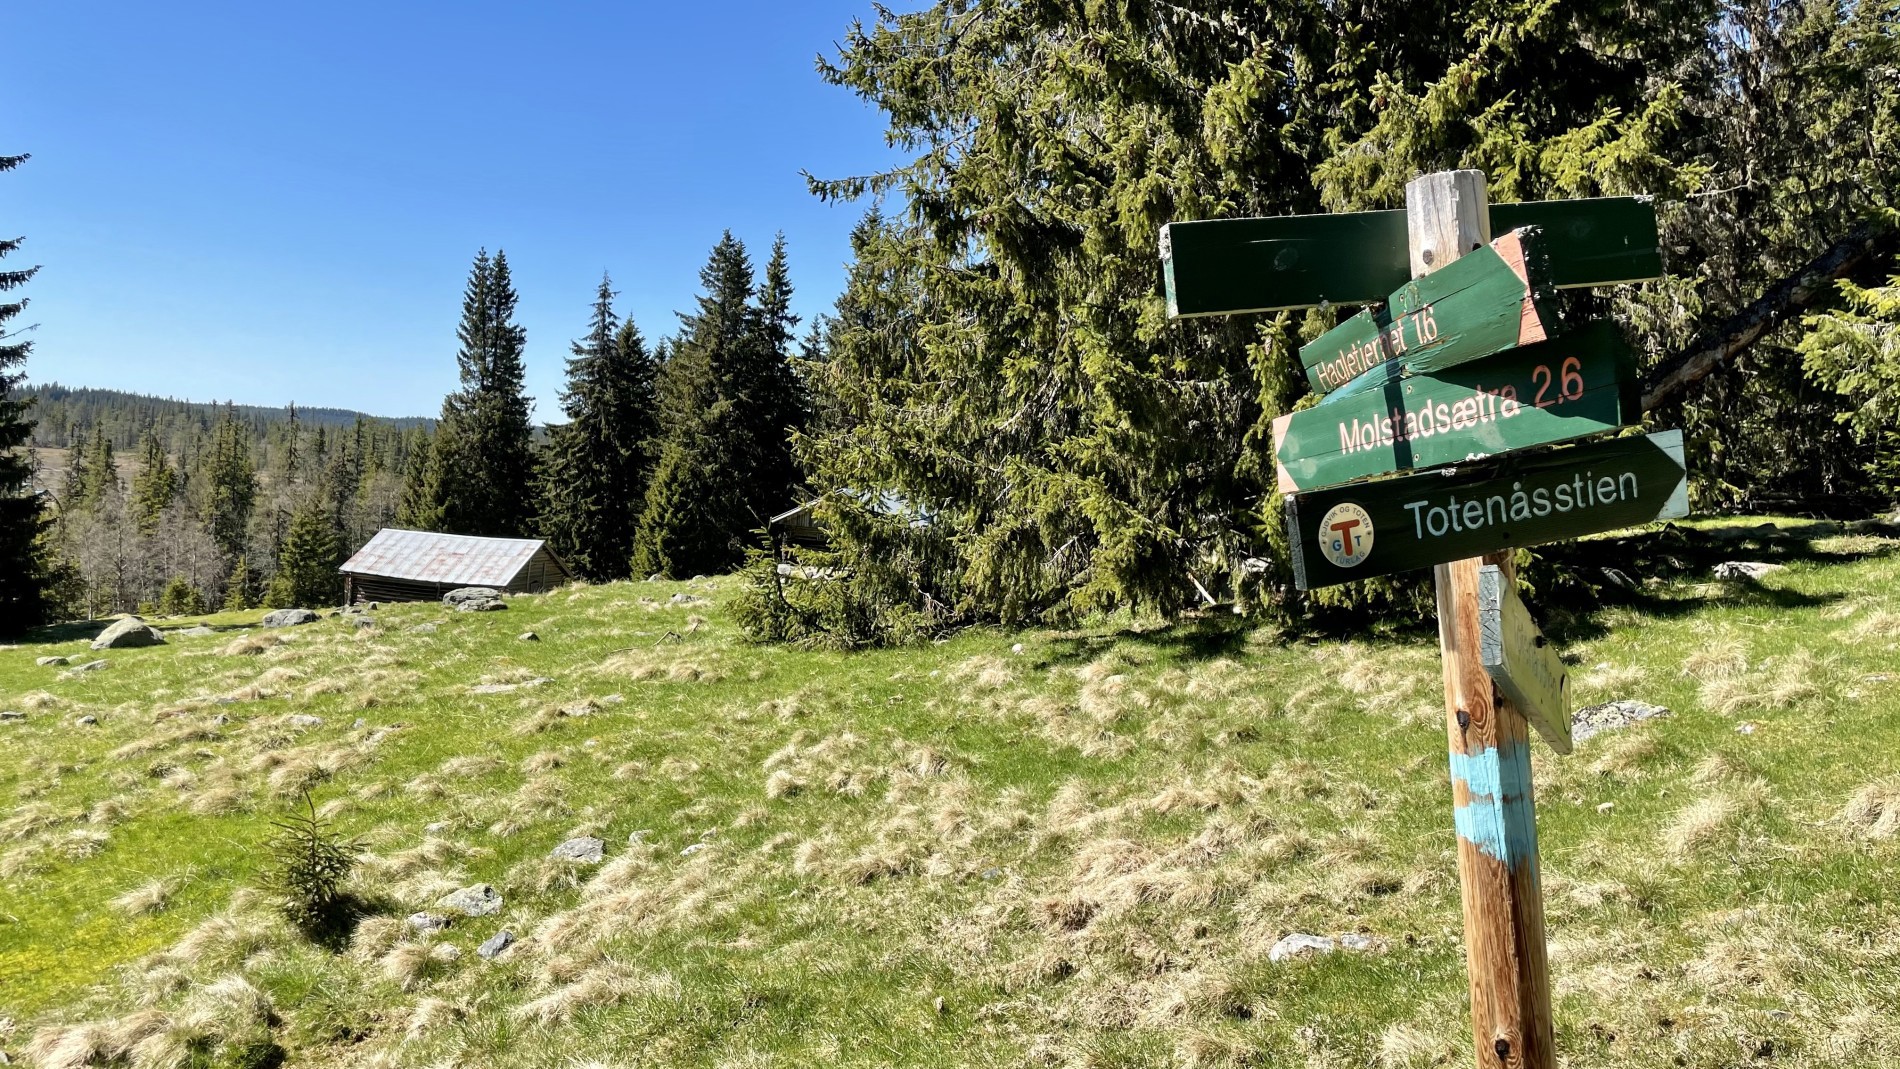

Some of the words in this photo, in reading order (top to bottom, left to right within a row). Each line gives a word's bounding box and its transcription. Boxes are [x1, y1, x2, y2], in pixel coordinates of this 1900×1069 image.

[1339, 384, 1521, 455] Molstadsætra
[1321, 510, 1338, 537] GJØVIK
[1339, 506, 1350, 514] OG
[1352, 507, 1371, 529] TOTEN
[1403, 471, 1638, 539] Totenåsstien
[1335, 551, 1366, 565] TURLAG
